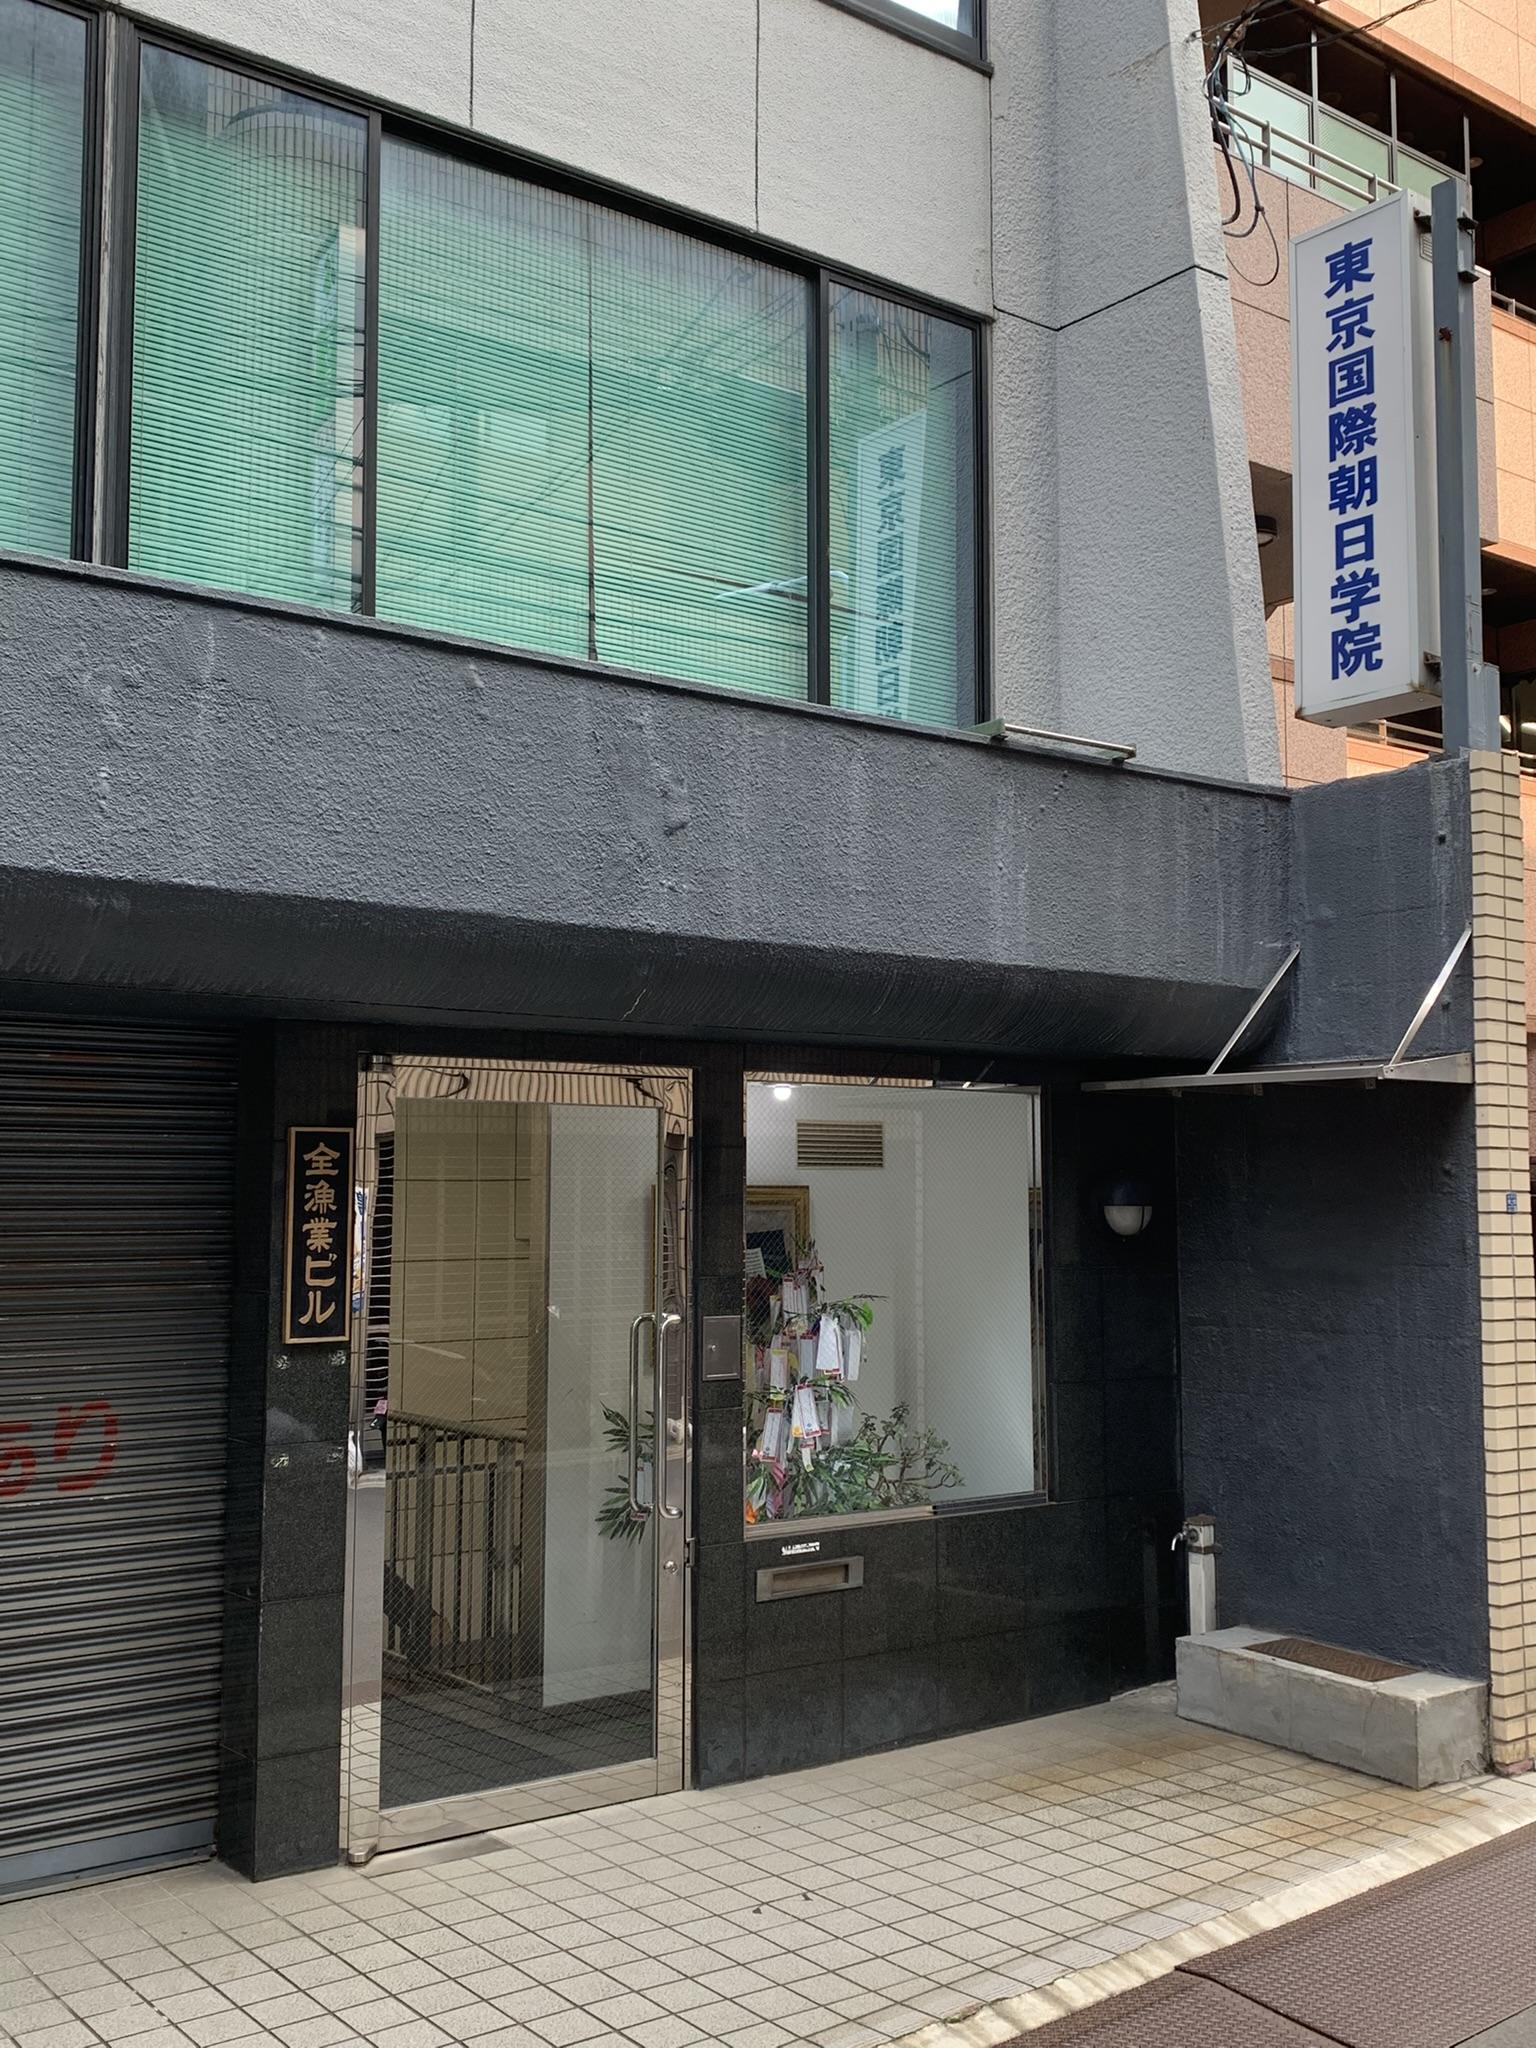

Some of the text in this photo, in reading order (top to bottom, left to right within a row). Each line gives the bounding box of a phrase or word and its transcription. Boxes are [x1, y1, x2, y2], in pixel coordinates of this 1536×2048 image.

[1324, 236, 1384, 680] 東京国際朝日学院
[298, 1141, 341, 1326] 全漁業ビル
